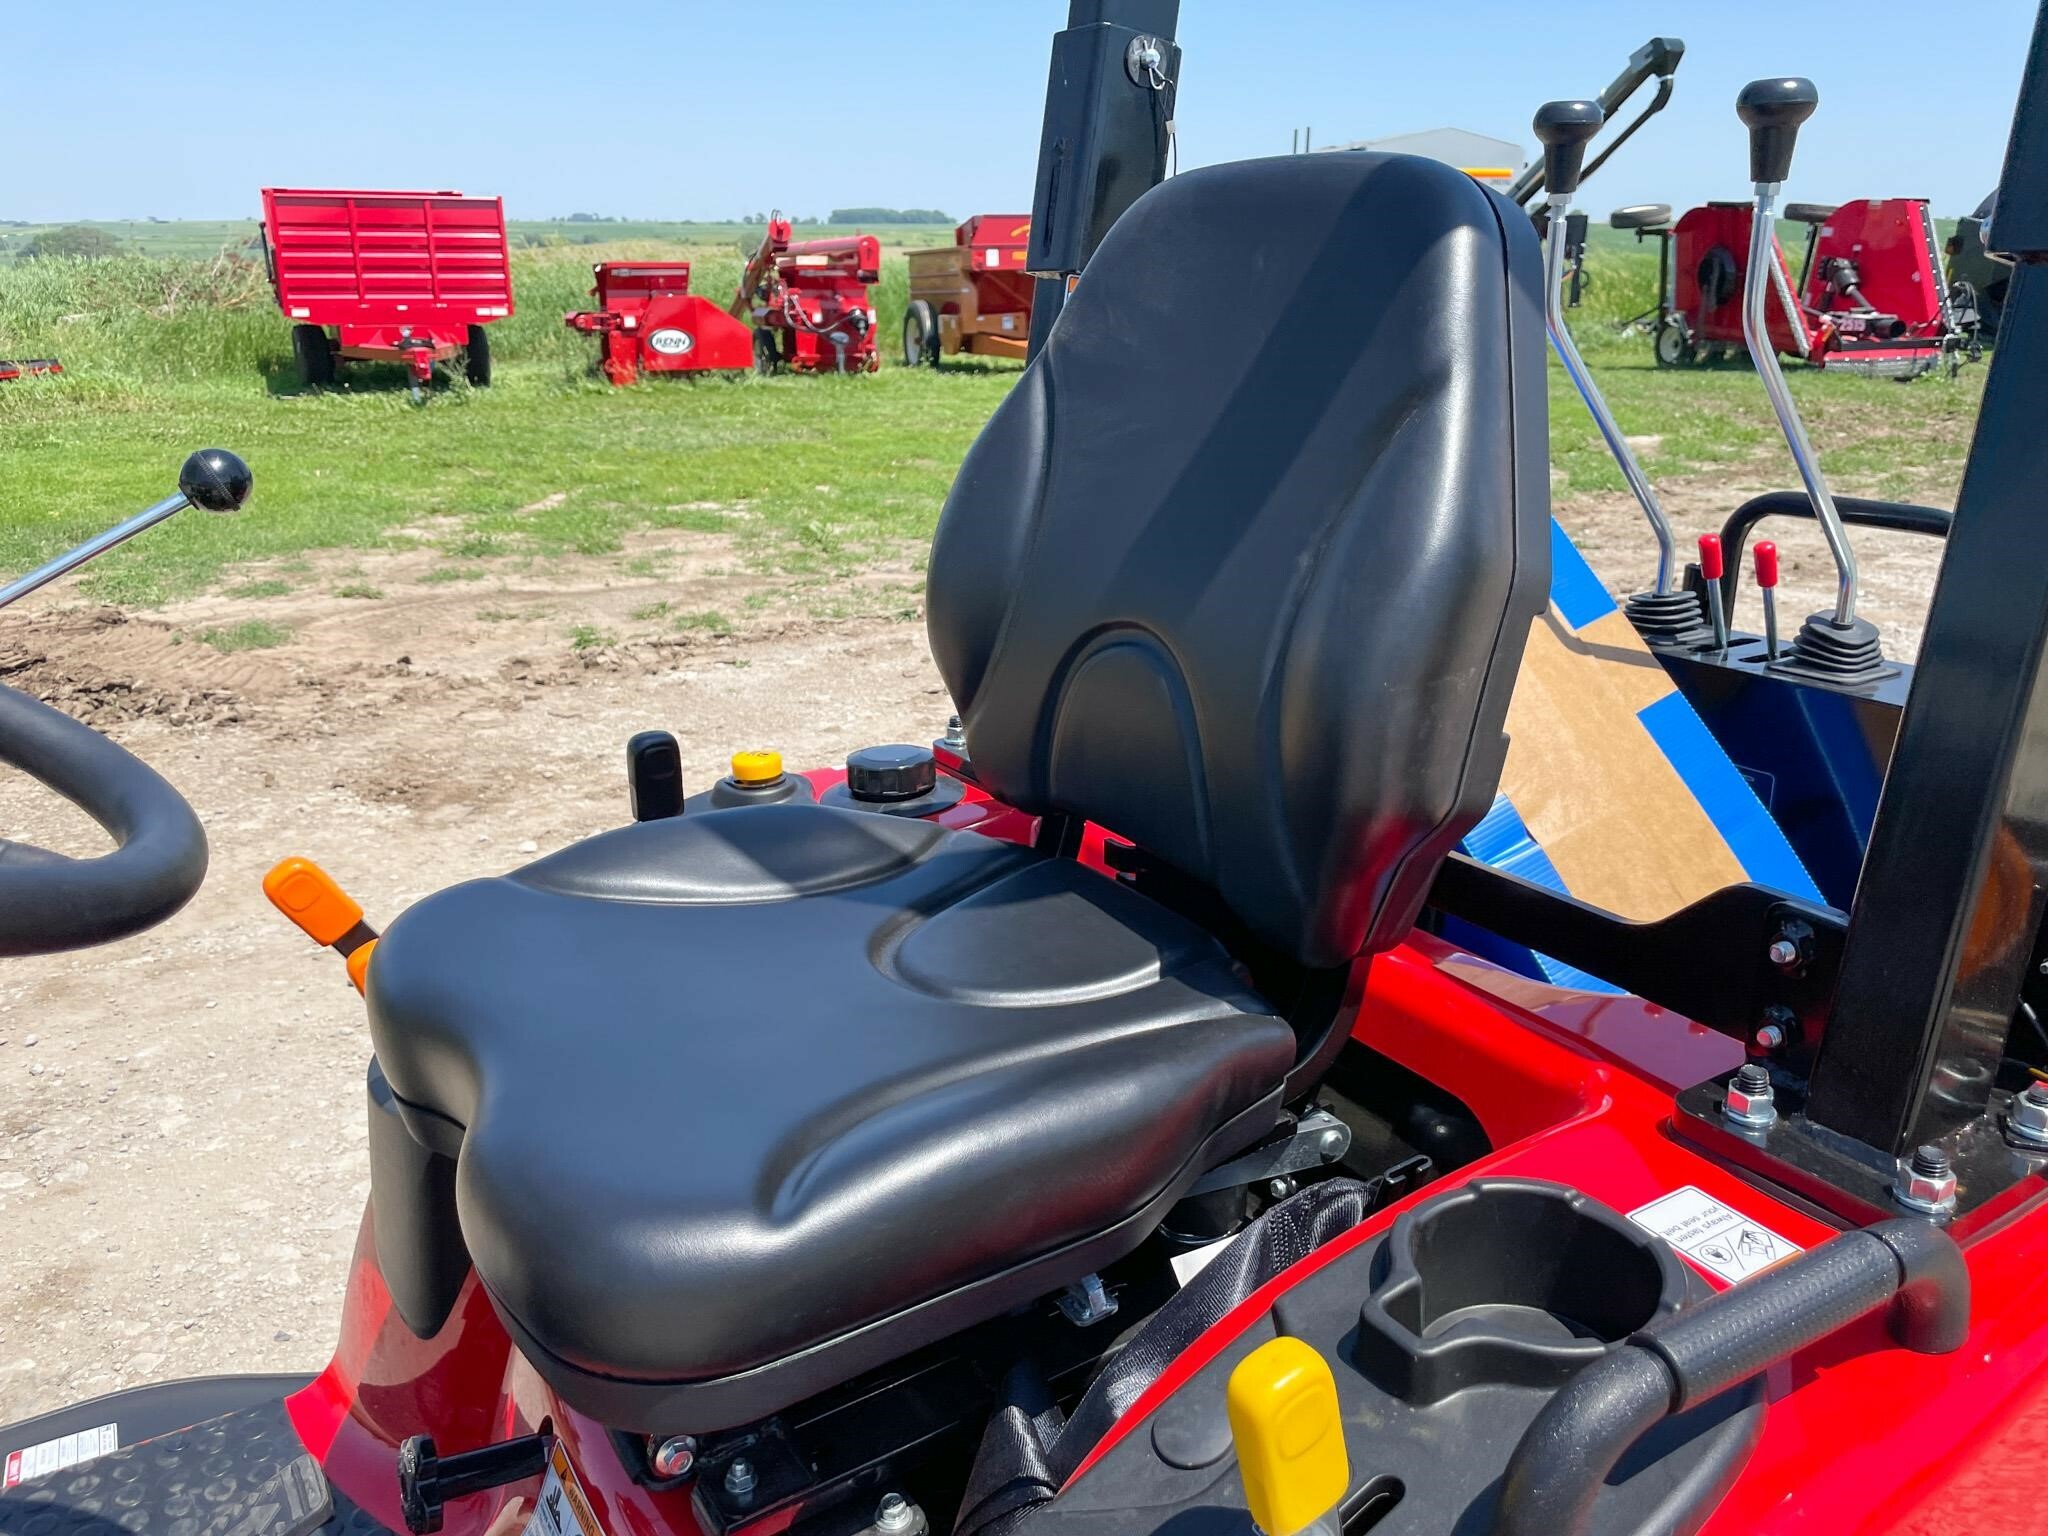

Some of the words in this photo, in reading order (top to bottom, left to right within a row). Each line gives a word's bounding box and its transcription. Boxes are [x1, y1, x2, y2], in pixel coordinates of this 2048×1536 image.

[1702, 1204, 1720, 1218] your
[1681, 1215, 1701, 1228] seat
[1702, 1213, 1734, 1229] Always
[1674, 1226, 1704, 1242] fasten
[569, 1488, 595, 1536] WARNING
